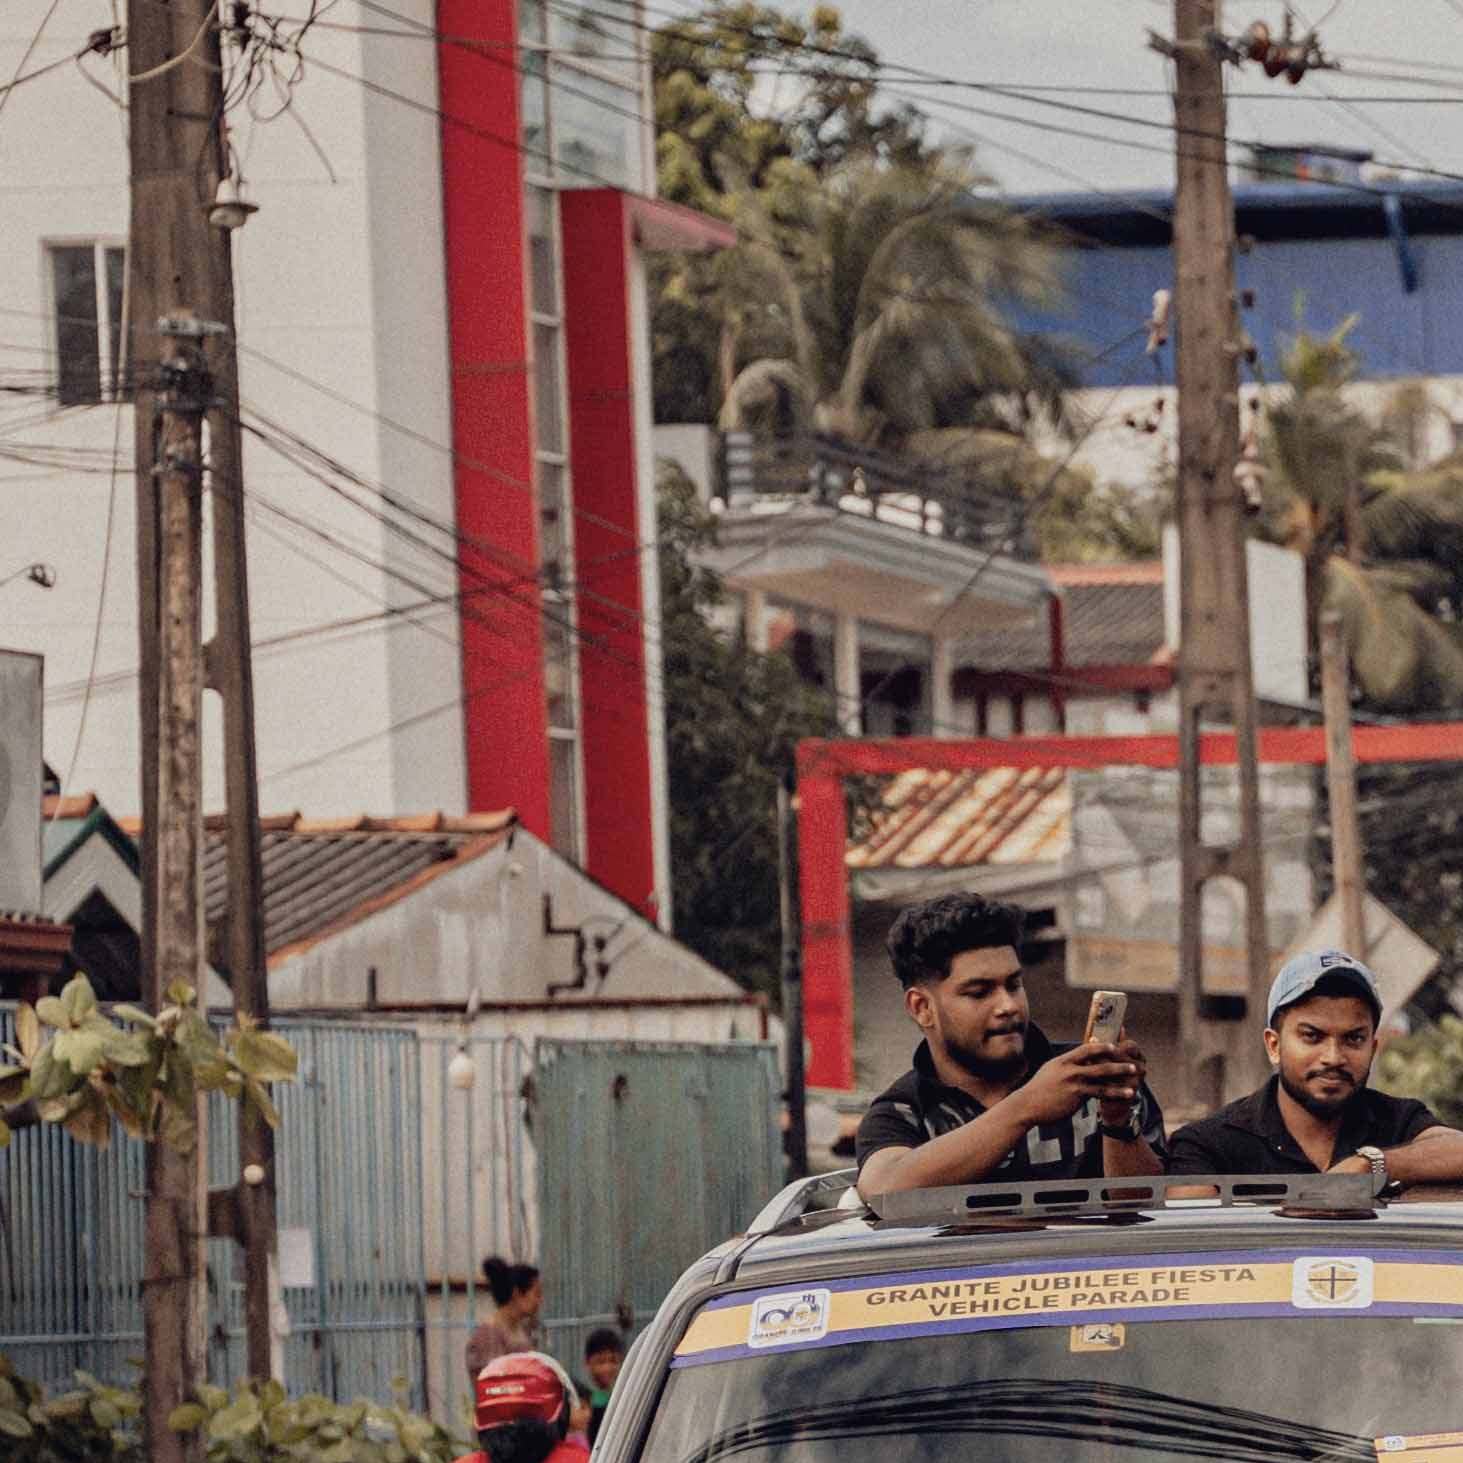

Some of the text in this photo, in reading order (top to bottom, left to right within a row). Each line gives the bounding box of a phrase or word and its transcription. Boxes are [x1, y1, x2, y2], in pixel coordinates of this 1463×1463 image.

[865, 1267, 1257, 1307] GRANITE JUBILEE FIESTA
[928, 1287, 1191, 1317] VEHICLE PARADE
